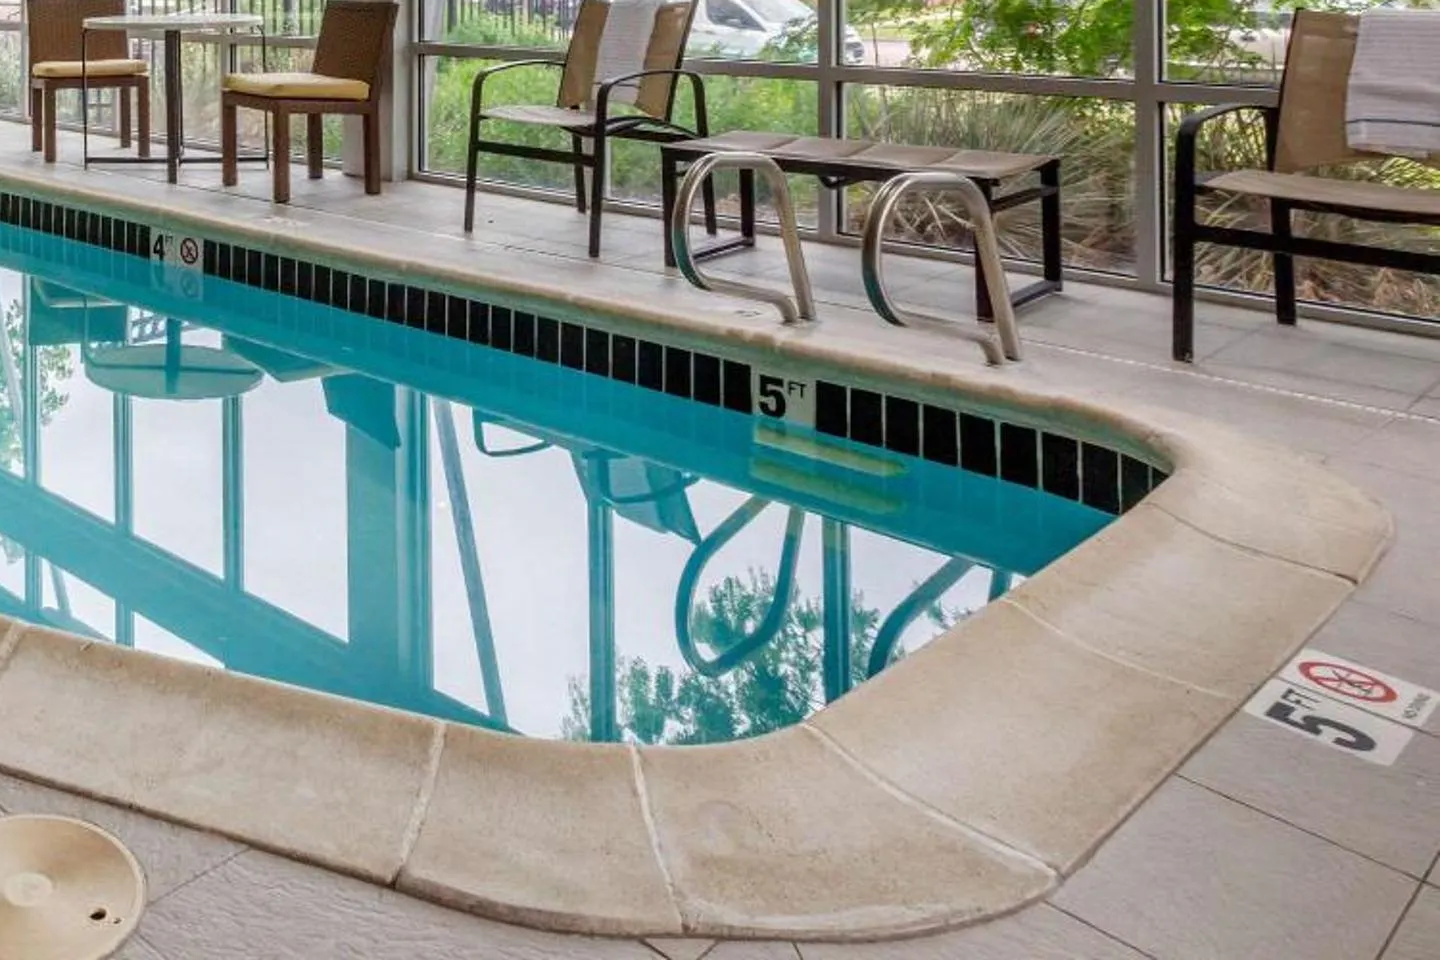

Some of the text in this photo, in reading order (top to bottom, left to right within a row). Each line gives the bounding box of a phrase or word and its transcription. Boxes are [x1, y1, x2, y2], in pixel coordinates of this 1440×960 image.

[153, 234, 165, 261] 4
[758, 374, 807, 418] 5 FT
[1265, 688, 1378, 752] 5 FT
